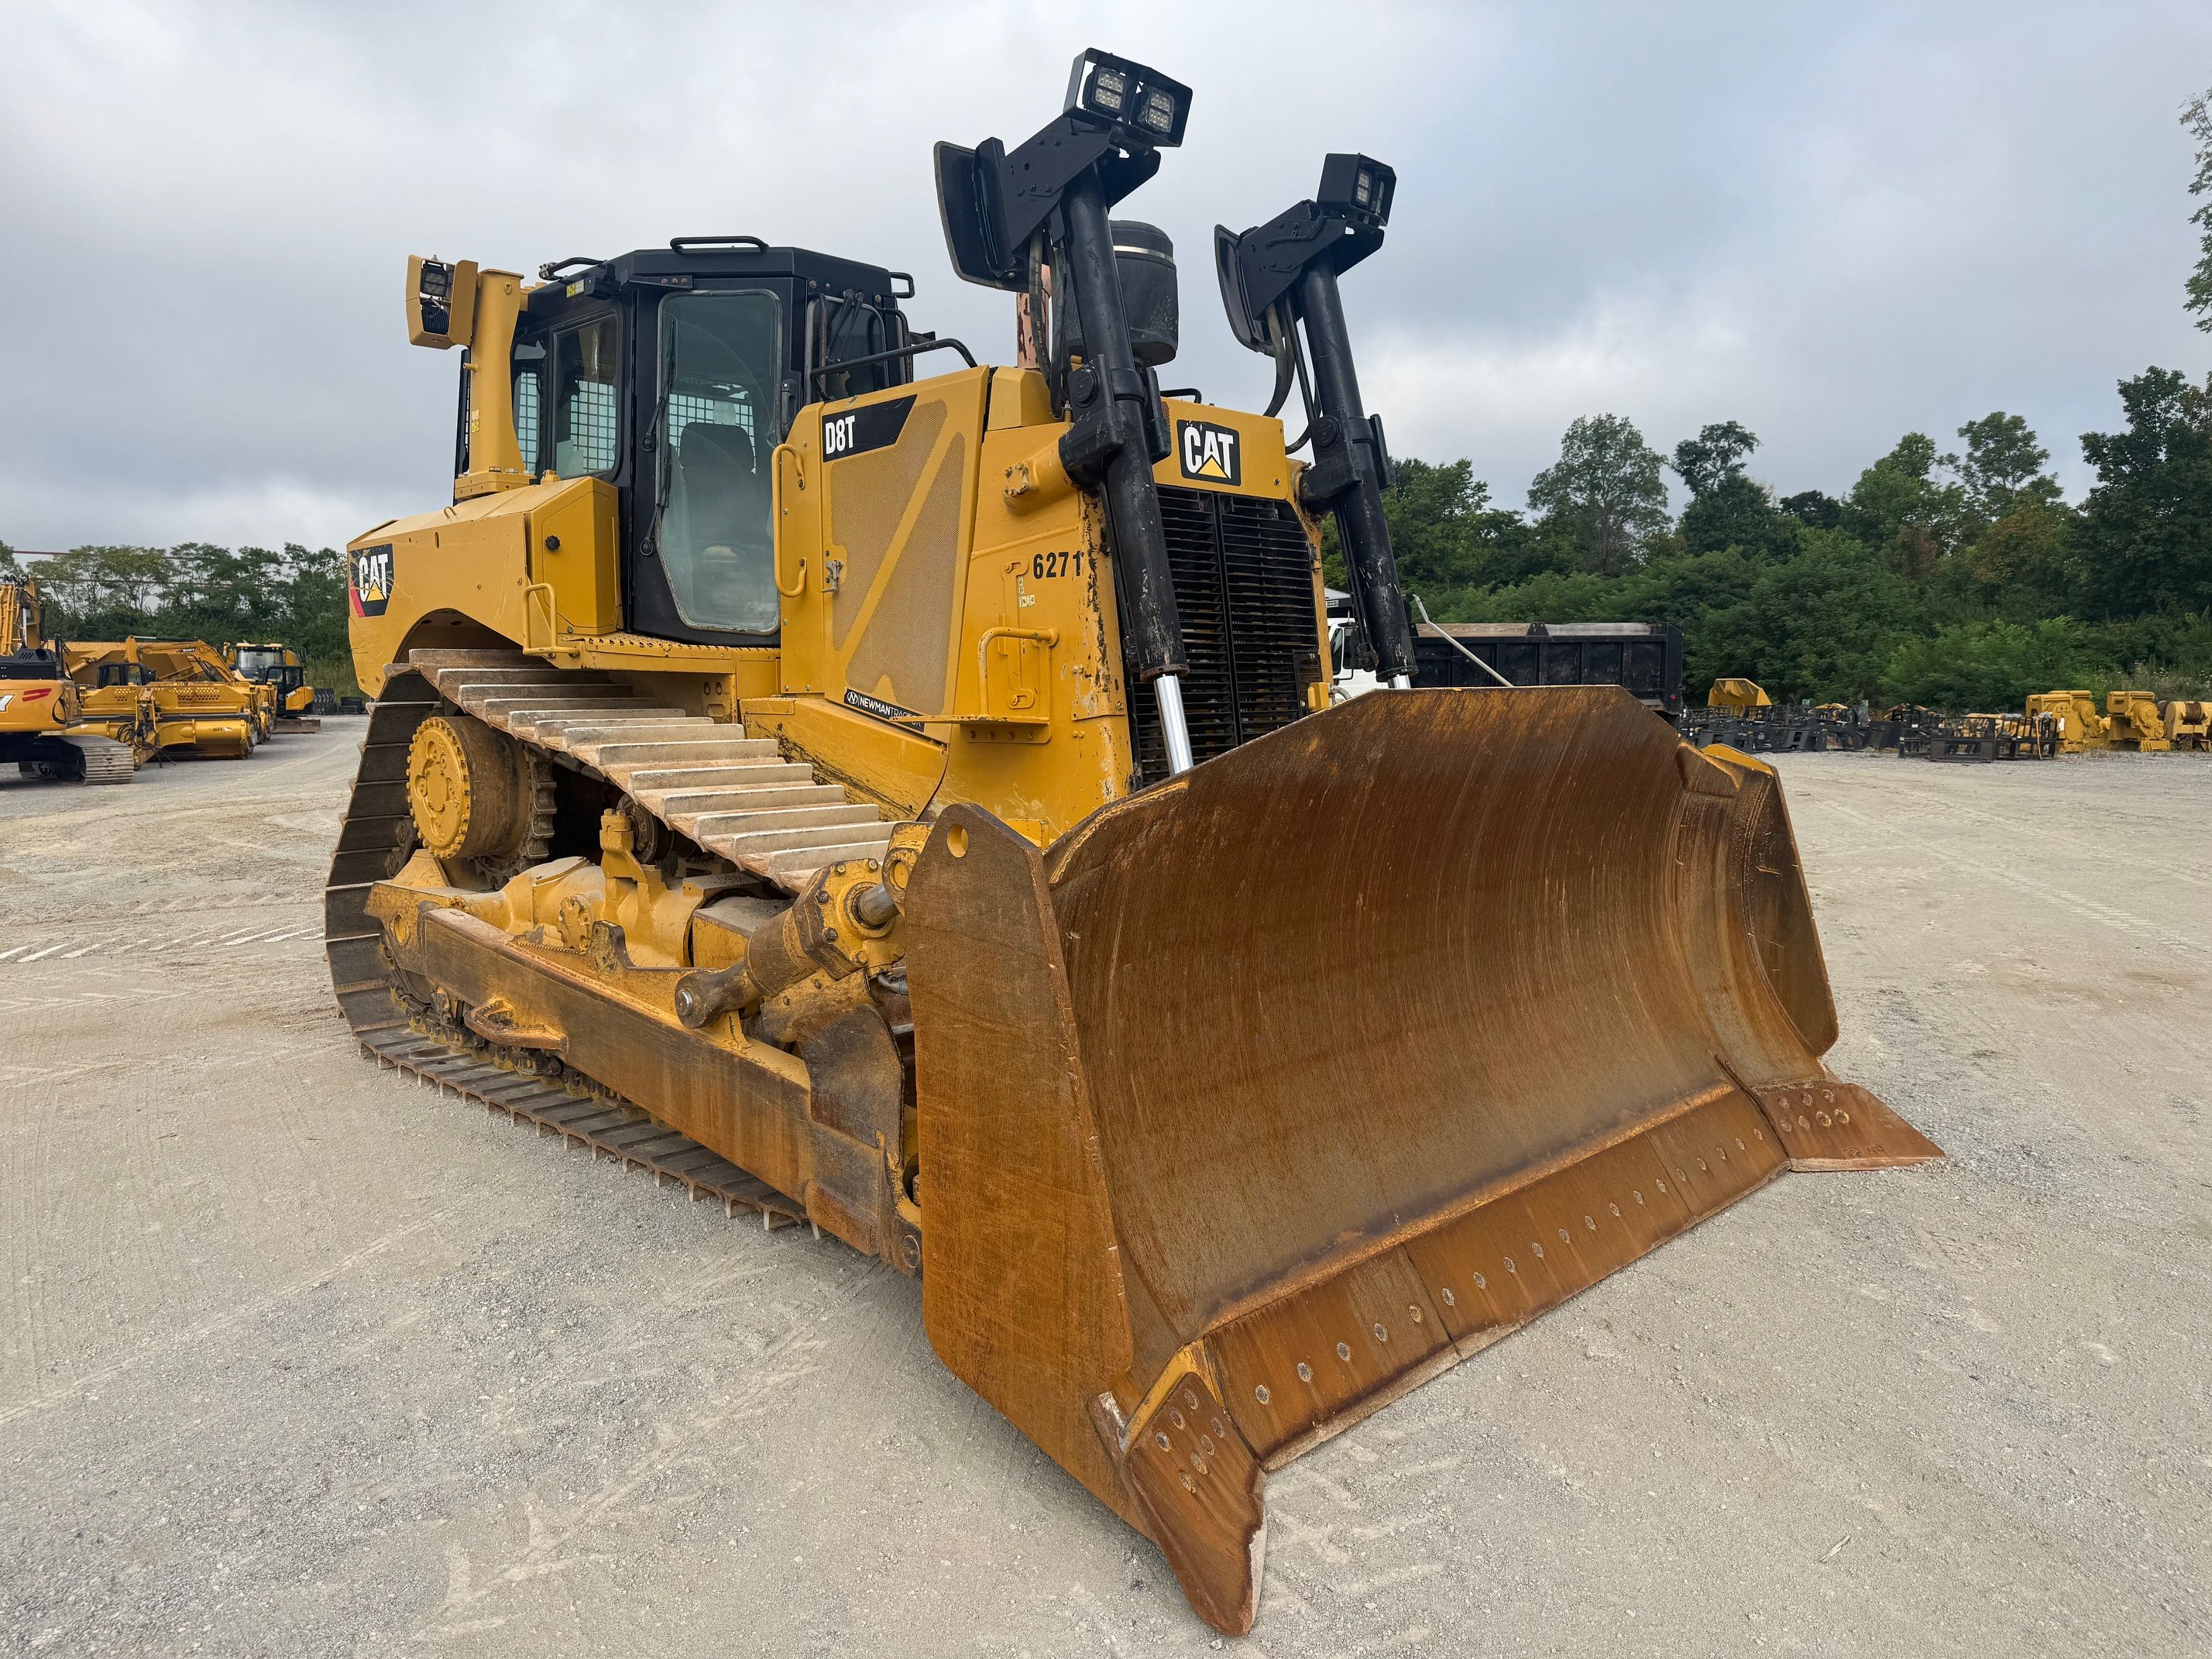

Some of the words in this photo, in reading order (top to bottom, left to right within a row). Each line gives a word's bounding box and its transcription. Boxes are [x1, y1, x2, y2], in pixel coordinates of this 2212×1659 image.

[825, 414, 855, 455] D8T
[1184, 426, 1234, 479] CAT
[359, 553, 388, 602] CAT
[1033, 551, 1080, 579] 6271
